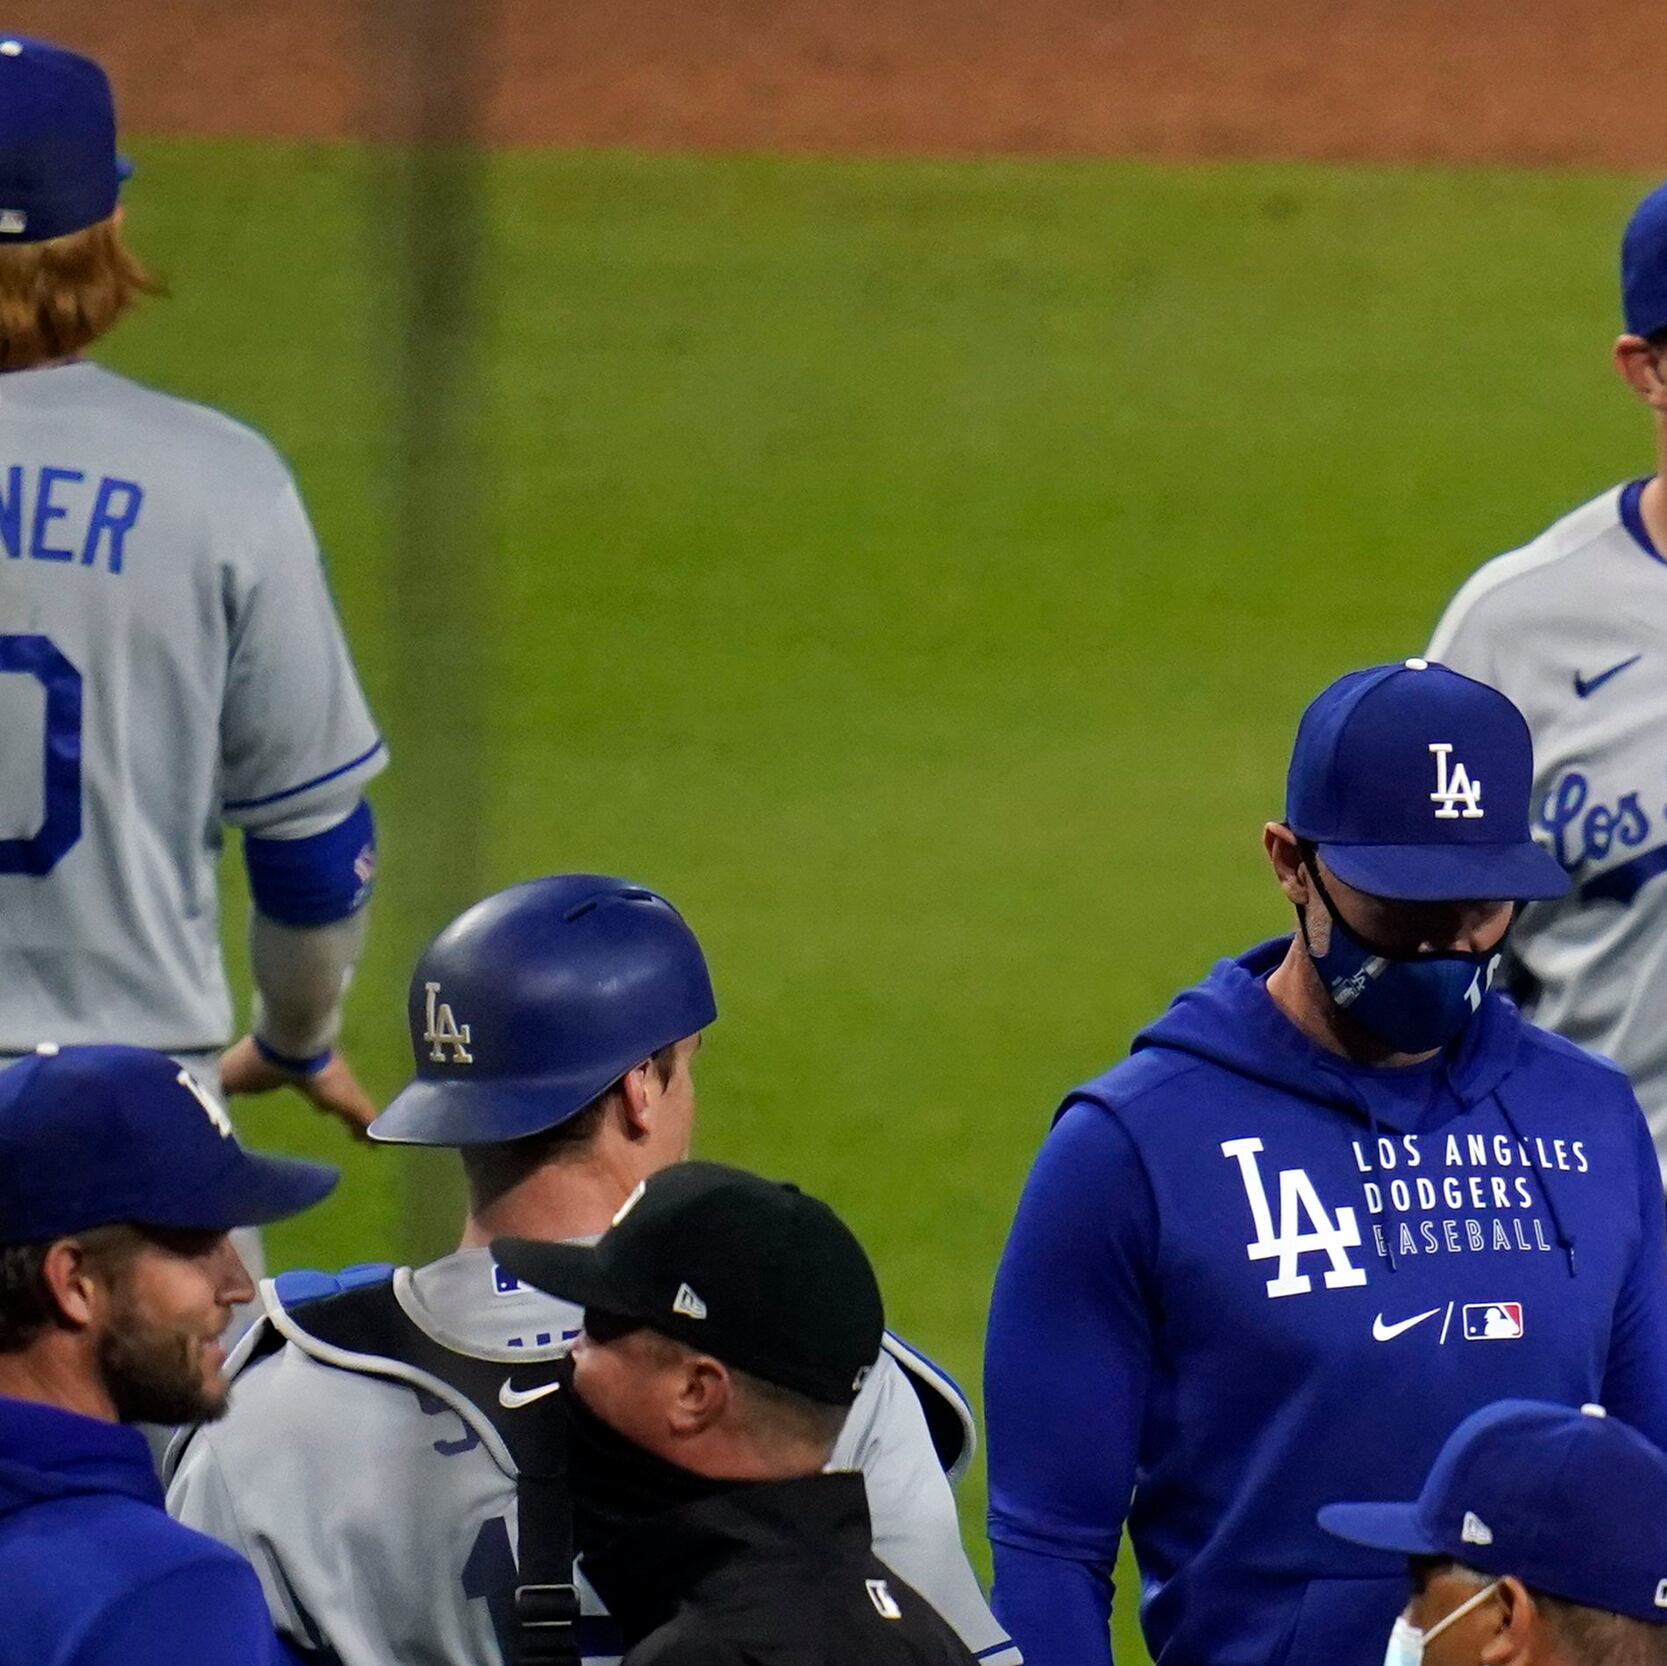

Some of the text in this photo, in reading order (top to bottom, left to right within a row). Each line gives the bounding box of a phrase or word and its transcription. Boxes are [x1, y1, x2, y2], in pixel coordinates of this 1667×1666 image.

[1428, 743, 1484, 818] LA
[1541, 772, 1650, 872] Los
[424, 981, 473, 1064] LA
[1352, 1134, 1421, 1173] LOS
[1220, 1137, 1368, 1299] LA
[1363, 1177, 1533, 1215] DODGERS
